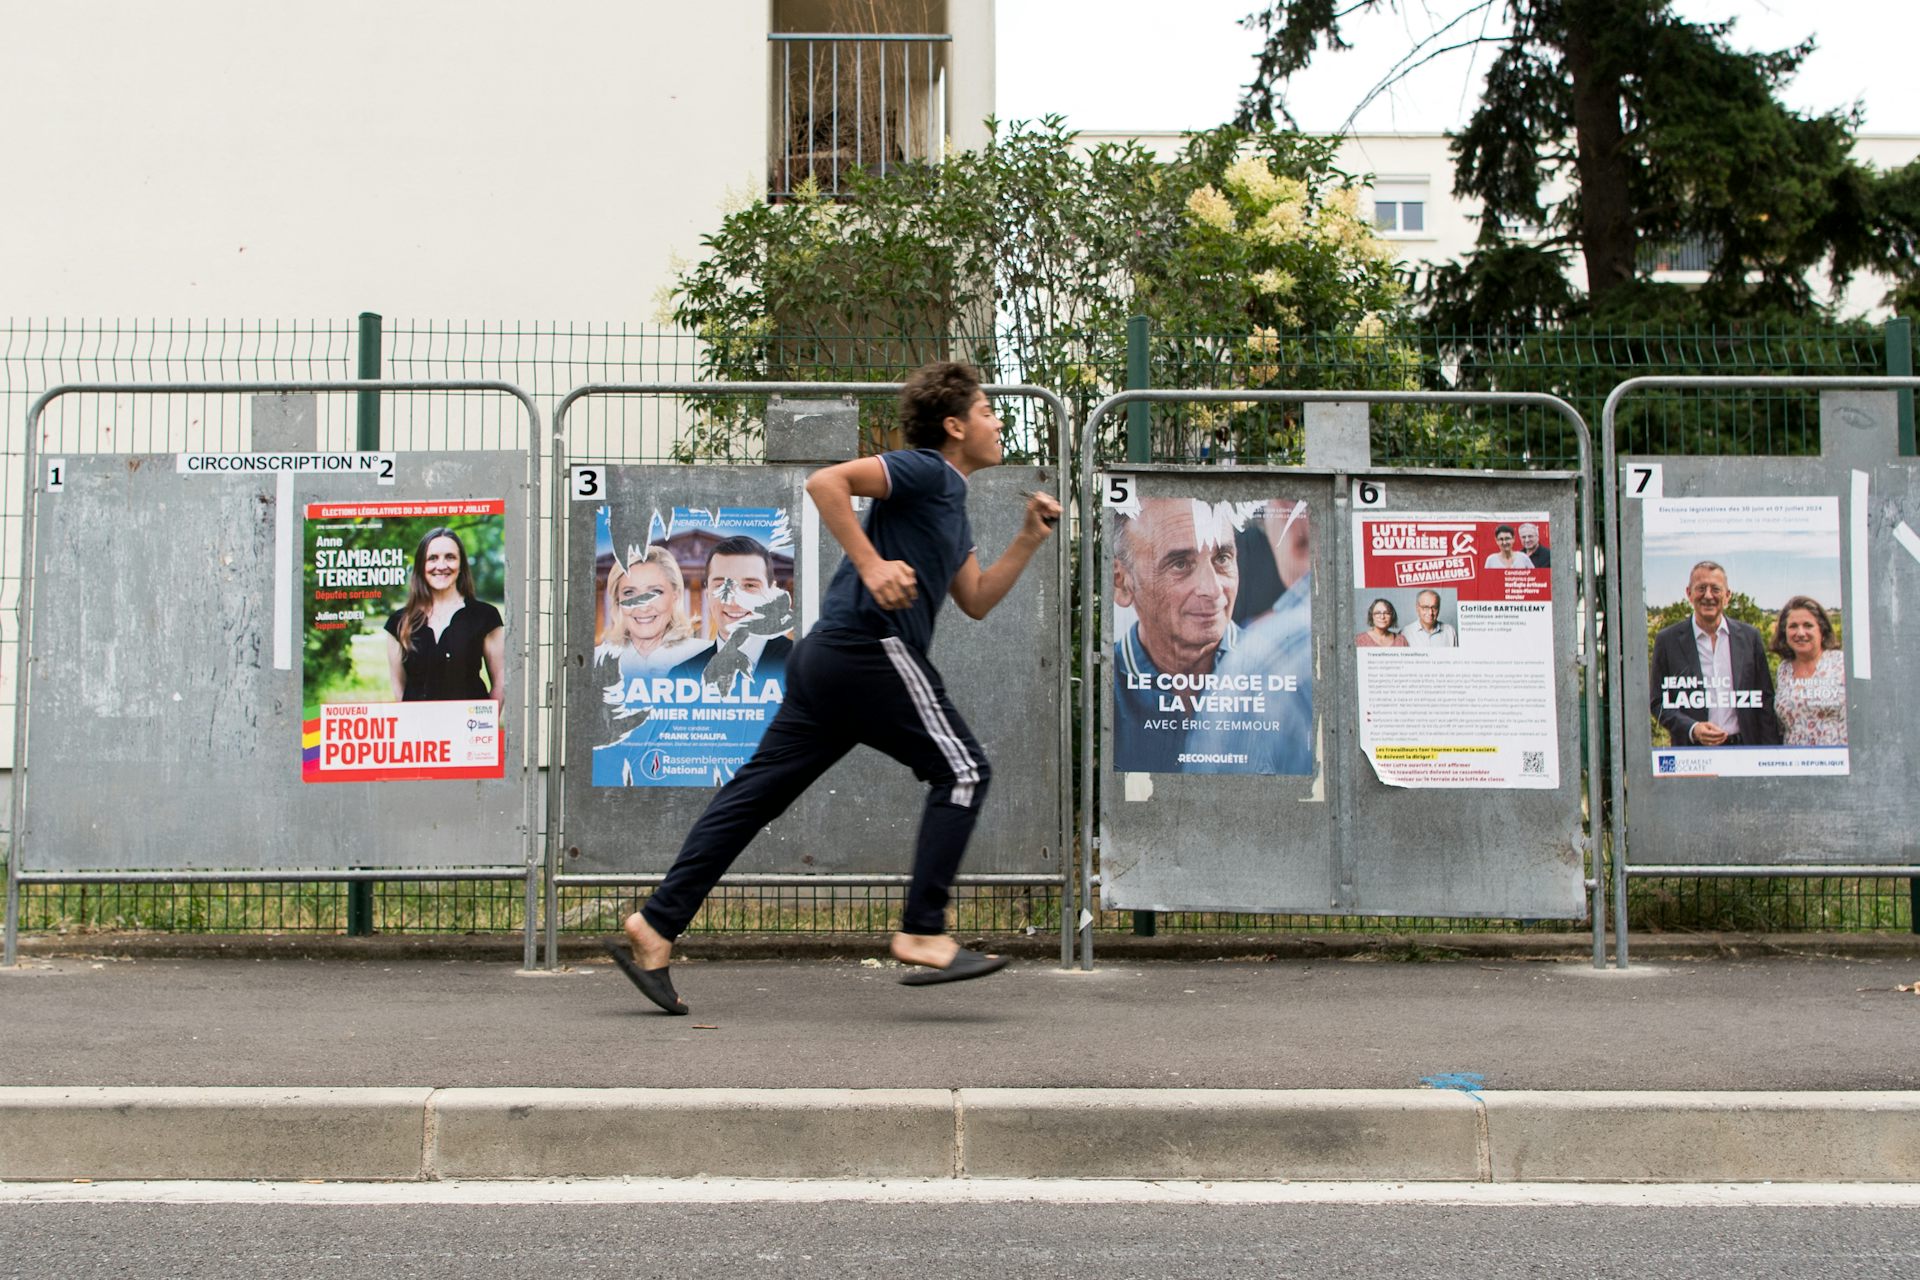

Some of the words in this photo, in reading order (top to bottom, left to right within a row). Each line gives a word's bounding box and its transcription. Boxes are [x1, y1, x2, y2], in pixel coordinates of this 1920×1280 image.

[188, 456, 352, 471] CIRCONSCRIPTION
[360, 456, 378, 470] N°
[379, 459, 394, 478] 2
[51, 467, 62, 485] 1
[578, 470, 598, 496] 3
[1633, 468, 1652, 493] 7
[1109, 478, 1128, 503] 5
[1359, 482, 1379, 504] 6
[321, 506, 357, 517] ÉLECTIONS
[358, 506, 402, 516] LÉGISLATIVES
[422, 506, 438, 515] JUIN
[439, 506, 447, 514] ET
[459, 505, 464, 514] 7
[464, 504, 490, 513] JUILLET
[1371, 523, 1417, 537] LUTTE
[316, 536, 343, 548] Anne
[1371, 534, 1448, 550] OUVRIÈRE
[315, 549, 409, 568] STAMBACH-
[1401, 562, 1415, 573] LE
[1415, 560, 1445, 572] CAMP
[1446, 558, 1465, 570] DES
[316, 567, 406, 587] TERRENOIR
[1399, 568, 1471, 584] TRAVAILLEURS
[315, 590, 347, 602] Députée
[349, 589, 382, 599] sortante
[315, 611, 338, 621] Julien
[1127, 673, 1152, 690] LE
[1156, 673, 1263, 691] COURAGE
[1268, 675, 1297, 692] DE
[1661, 676, 1731, 689] JEAN-LUC
[1662, 690, 1763, 709] LAGLEIZE
[1800, 688, 1840, 699] LEROY
[1158, 695, 1186, 712] LA
[1189, 692, 1266, 713] VÉRITÉ
[326, 706, 368, 716] NOUVEAU
[692, 708, 765, 721] MINISTRE
[326, 717, 398, 740] FRONT
[1144, 719, 1178, 731] AVEC
[1182, 718, 1211, 731] ÉRIC
[1215, 720, 1280, 732] ZEMMOUR
[475, 735, 493, 744] PCF
[659, 732, 689, 740] FRANK
[690, 732, 727, 740] KHALIFA
[325, 740, 451, 765] POPULAIRE
[662, 755, 745, 765] Rassemblement
[662, 765, 707, 775] National
